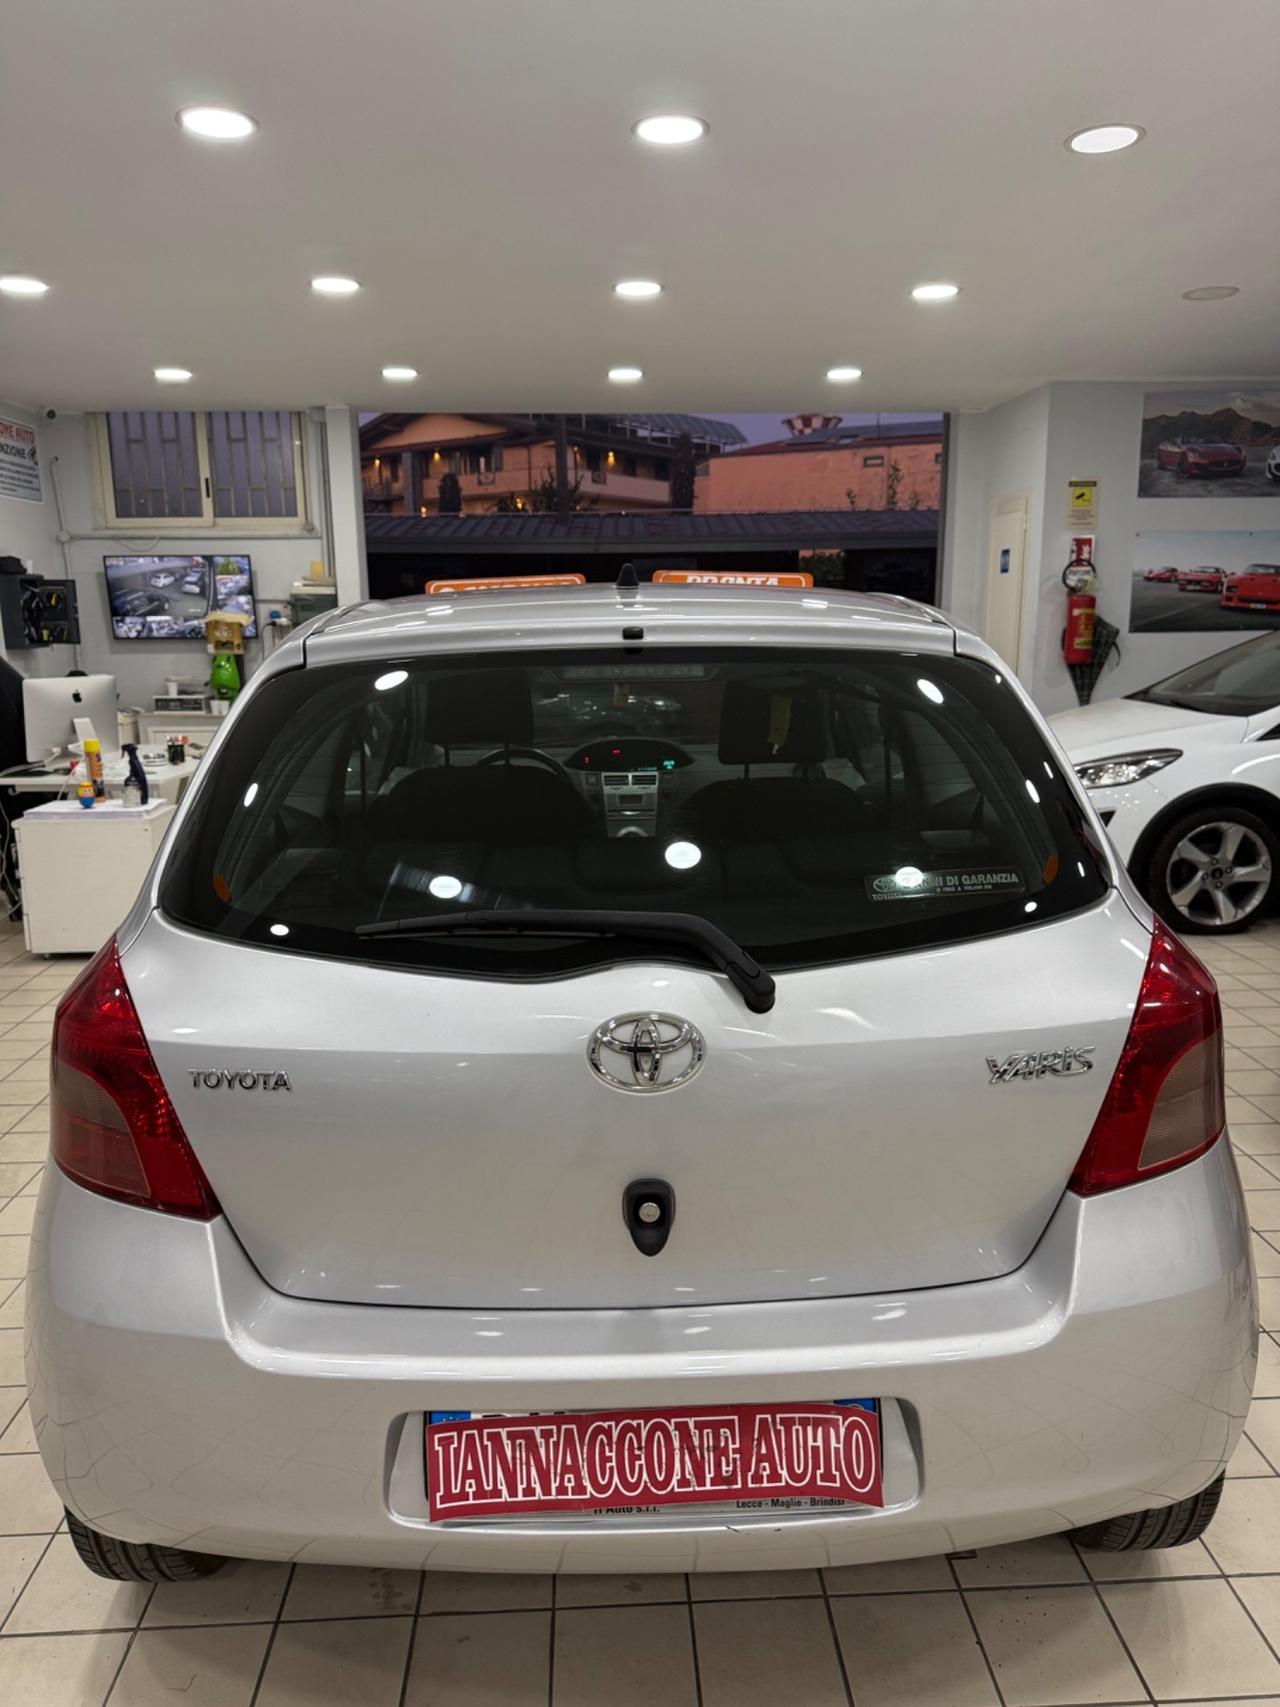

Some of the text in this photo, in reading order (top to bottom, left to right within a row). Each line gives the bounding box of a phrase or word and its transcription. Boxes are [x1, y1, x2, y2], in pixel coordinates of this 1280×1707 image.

[946, 876, 959, 886] DI
[961, 873, 1019, 885] GARANZIA
[188, 1068, 293, 1091] TOYOTA
[434, 1413, 876, 1509] IANNACCONE AUTO
[736, 1499, 763, 1508] Lecce
[771, 1498, 802, 1509] Maglie
[810, 1497, 845, 1507] Brindisi
